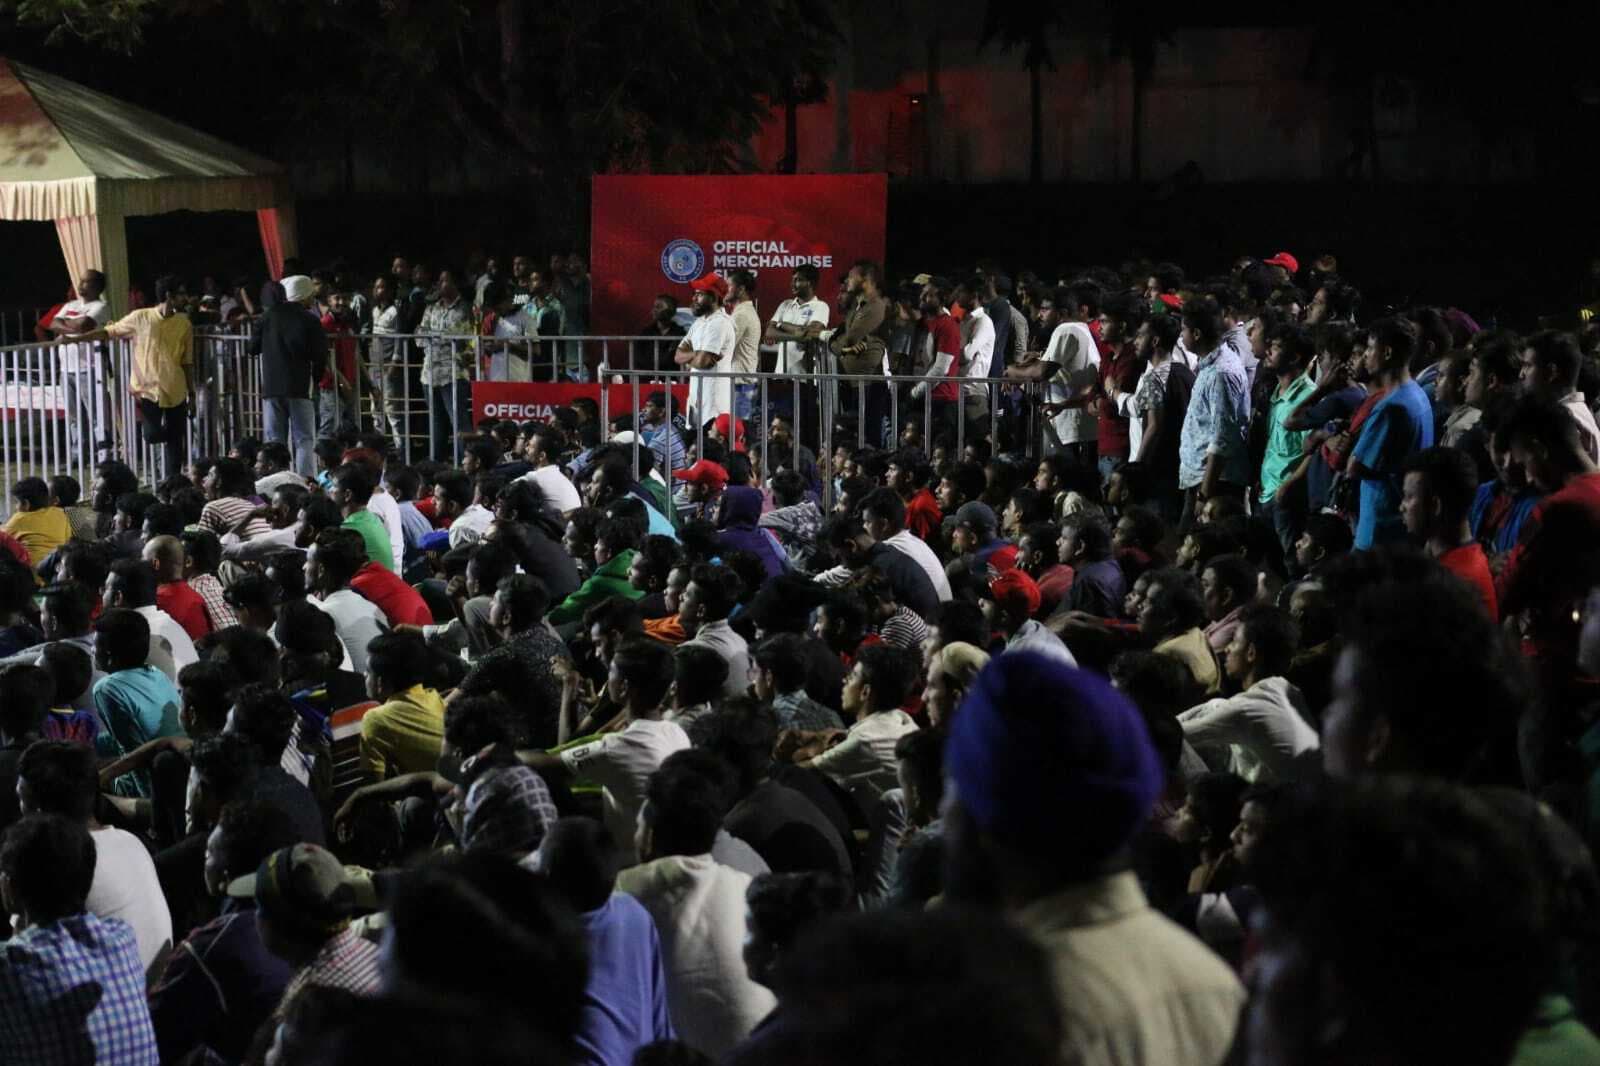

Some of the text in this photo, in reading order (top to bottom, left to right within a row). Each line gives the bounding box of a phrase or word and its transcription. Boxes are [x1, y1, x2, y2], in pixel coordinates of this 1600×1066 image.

[714, 241, 789, 254] OFFICIAL
[714, 255, 832, 268] MERCHANDISE
[483, 403, 560, 417] OFFICIA
